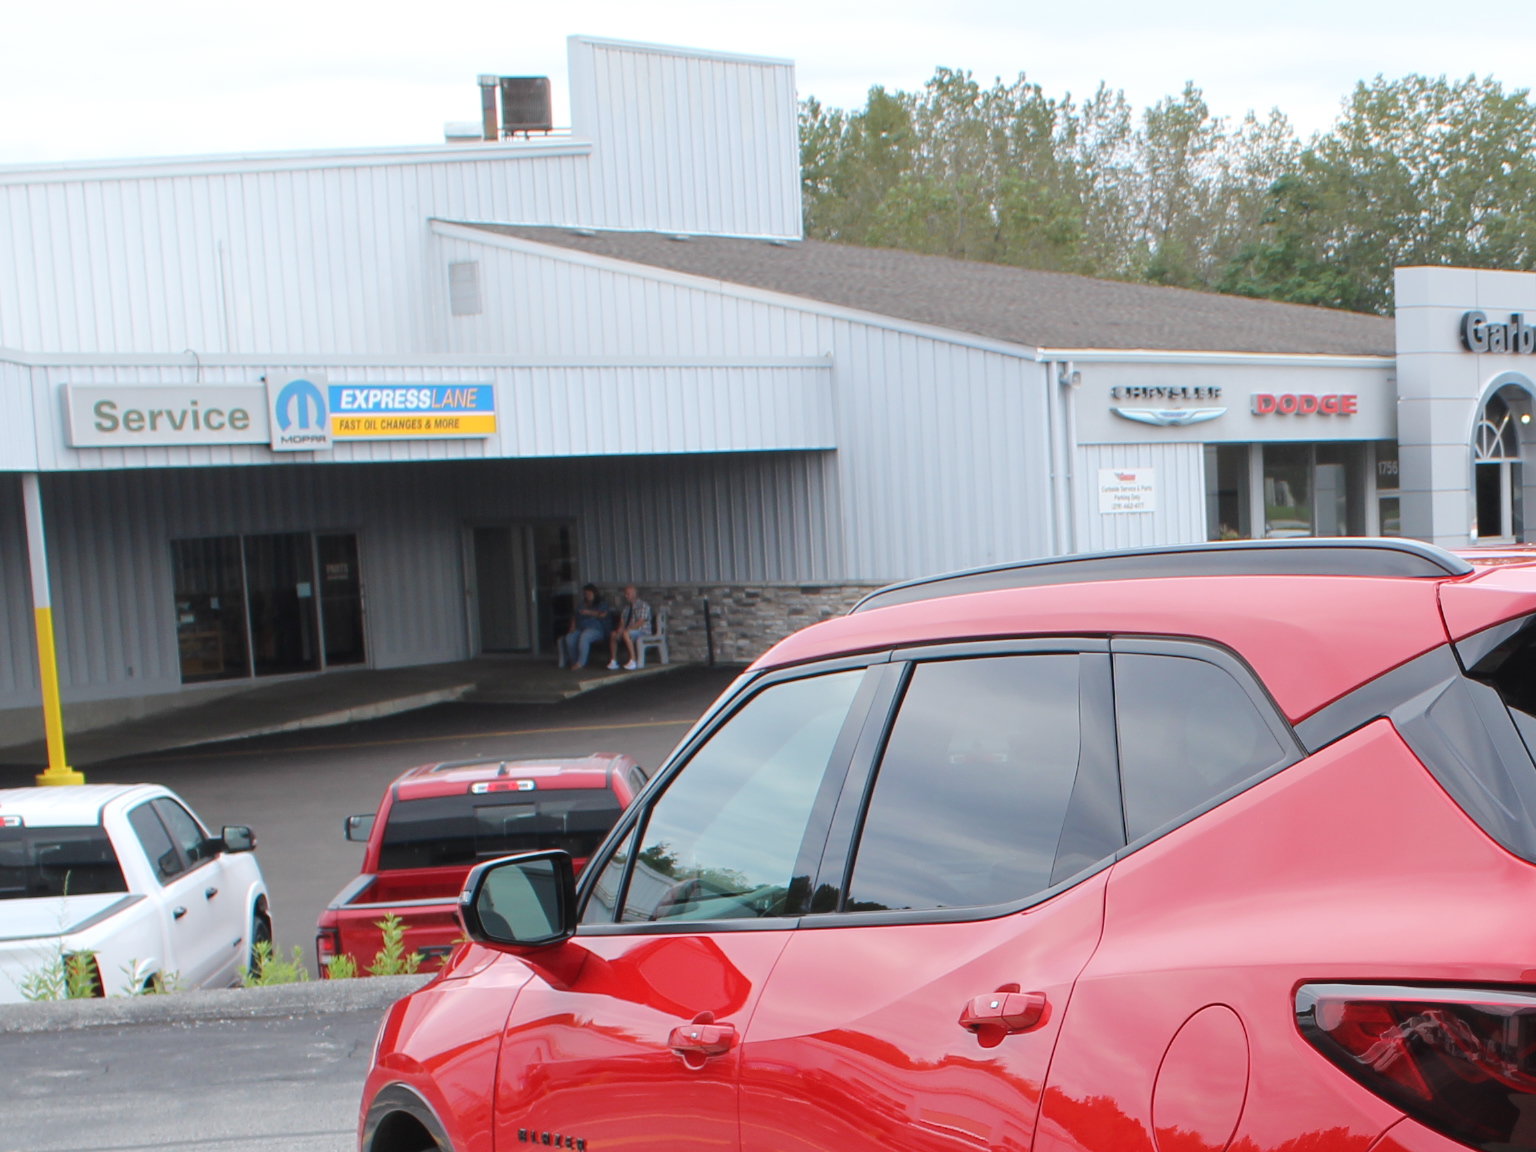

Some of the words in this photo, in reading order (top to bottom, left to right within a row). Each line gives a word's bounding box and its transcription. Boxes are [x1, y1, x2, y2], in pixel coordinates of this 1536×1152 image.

[1110, 386, 1222, 400] CHRYSLER
[1253, 394, 1358, 416] DODGE
[93, 400, 251, 434] Service
[339, 420, 361, 431] FAST
[364, 419, 378, 430] OIL
[380, 418, 423, 429] CHANGES
[424, 418, 432, 428] &
[434, 418, 460, 429] MORE
[280, 435, 327, 445] MOPAR
[1377, 461, 1399, 476] 1756
[517, 1128, 587, 1152] BLAZER
